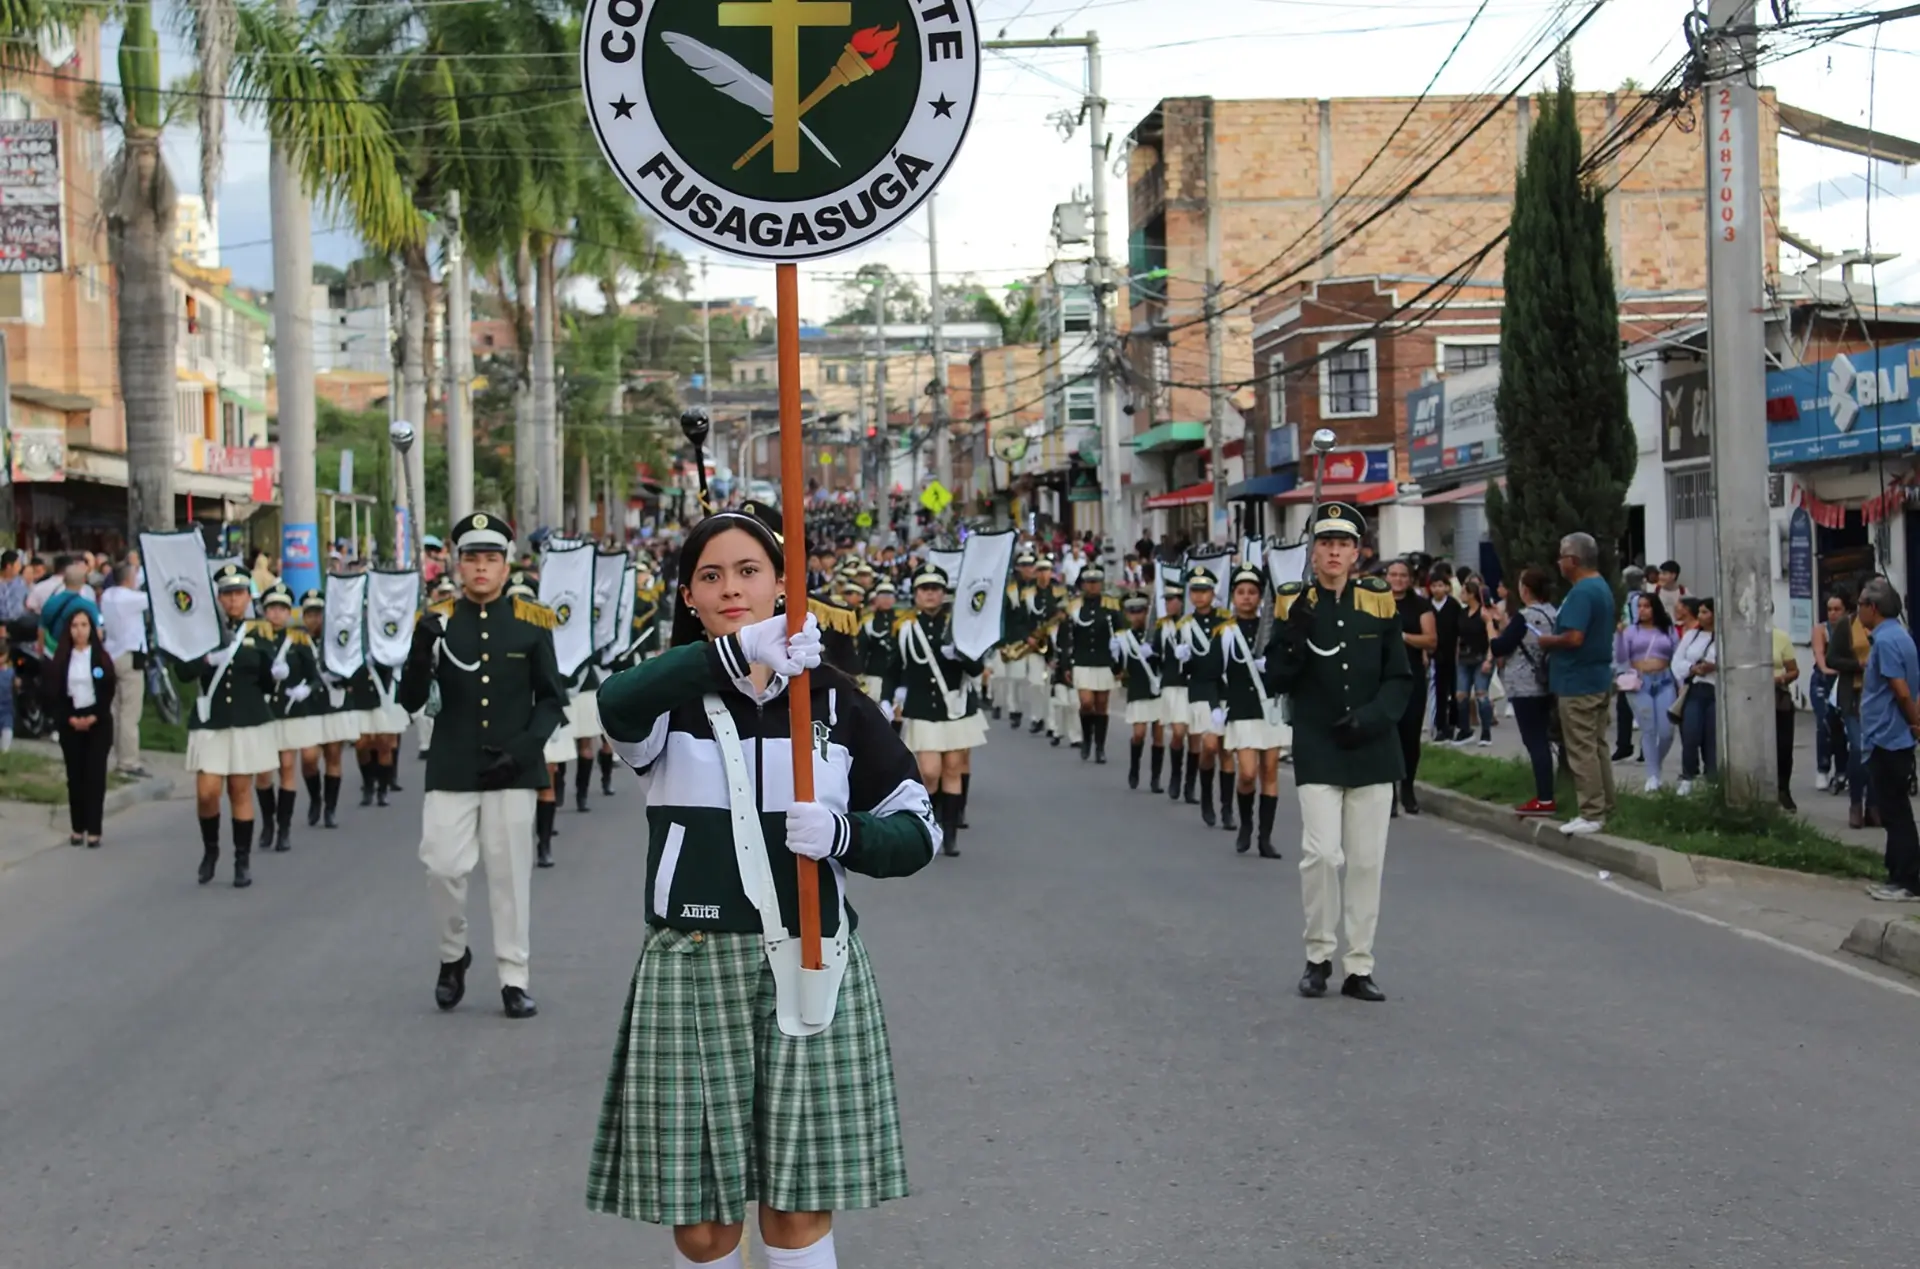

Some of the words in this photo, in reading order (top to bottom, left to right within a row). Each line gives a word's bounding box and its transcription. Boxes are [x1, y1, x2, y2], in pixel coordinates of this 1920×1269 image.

[637, 148, 934, 247] FUSAGASUGÁ
[1718, 88, 1736, 242] 27487003
[680, 904, 720, 919] Anita
